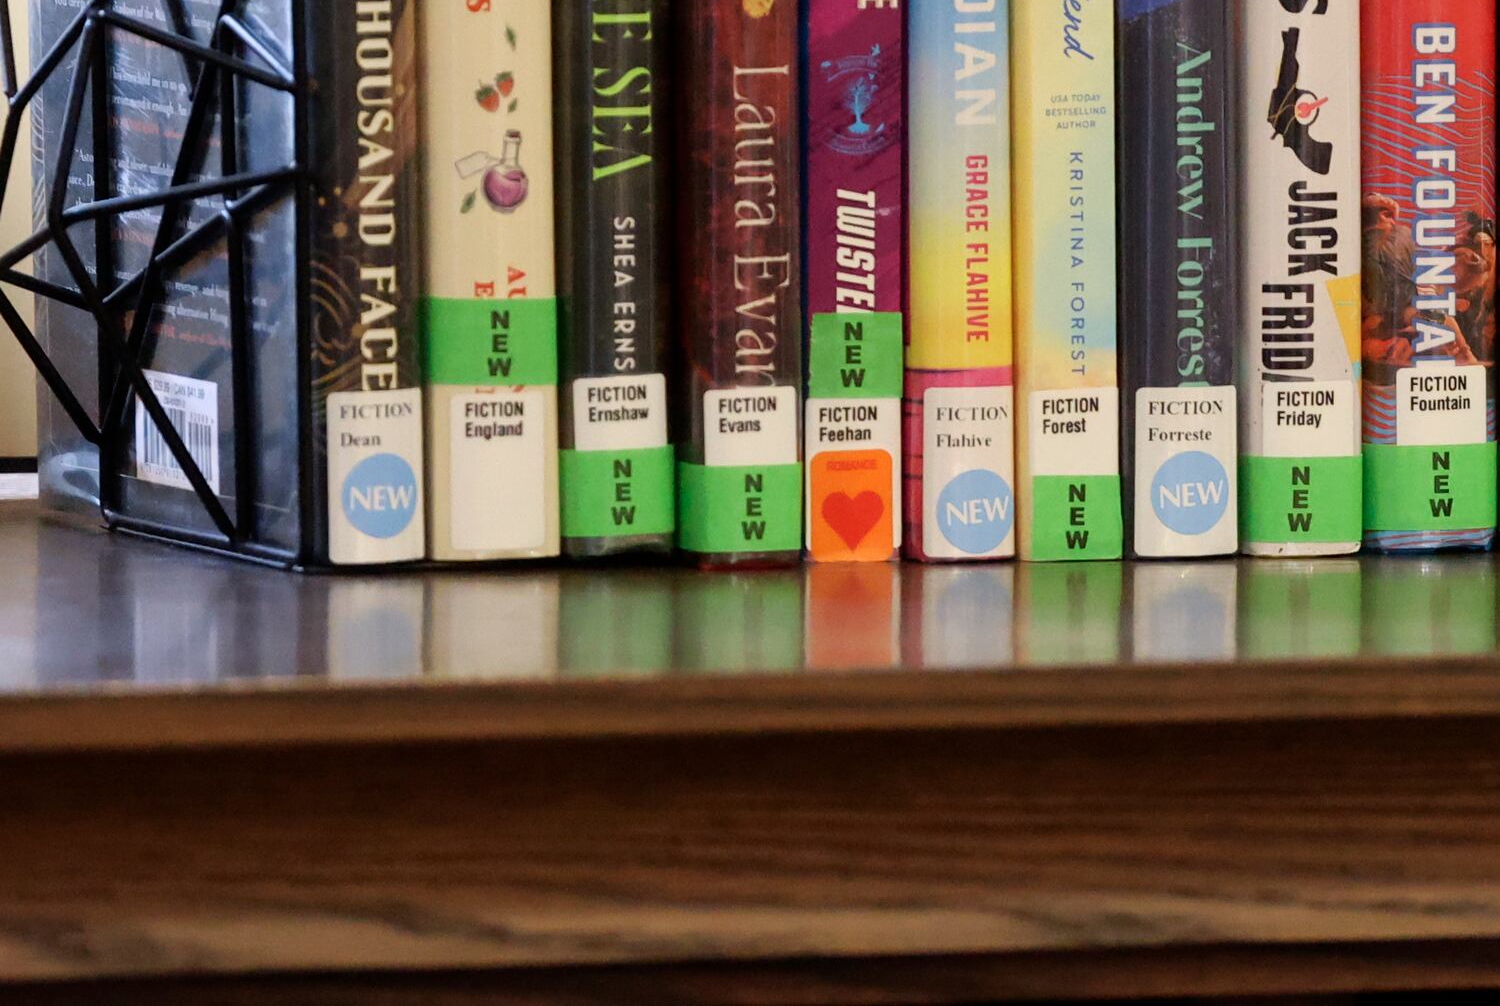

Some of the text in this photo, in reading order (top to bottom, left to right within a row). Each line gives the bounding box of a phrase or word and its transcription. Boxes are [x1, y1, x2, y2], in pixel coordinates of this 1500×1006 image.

[1413, 24, 1456, 124] BEN
[1050, 94, 1068, 103] USA
[1045, 106, 1106, 116] BESTSELLING
[592, 66, 652, 182] SEA
[1056, 120, 1096, 129] AUTHOR
[1175, 37, 1215, 221] Andrew
[733, 65, 789, 228] Laura
[1287, 181, 1338, 276] JACK
[613, 216, 635, 287] SHEA
[965, 155, 989, 343] GRACE FLAHIVE
[1069, 151, 1085, 376] KRISTINA FOREST
[339, 402, 413, 420] FICTION
[1410, 395, 1471, 412] Fountain
[588, 406, 649, 421] Ernshaw
[1277, 411, 1322, 428] Friday
[465, 421, 523, 439] England
[718, 418, 762, 433] Evans
[819, 425, 872, 442] Feehan
[1042, 418, 1087, 434] Forest
[1148, 427, 1213, 441] Forreste
[340, 432, 382, 447] Dean
[936, 433, 992, 448] Flahive
[1430, 451, 1453, 518] NEW
[349, 485, 416, 511] NEW
